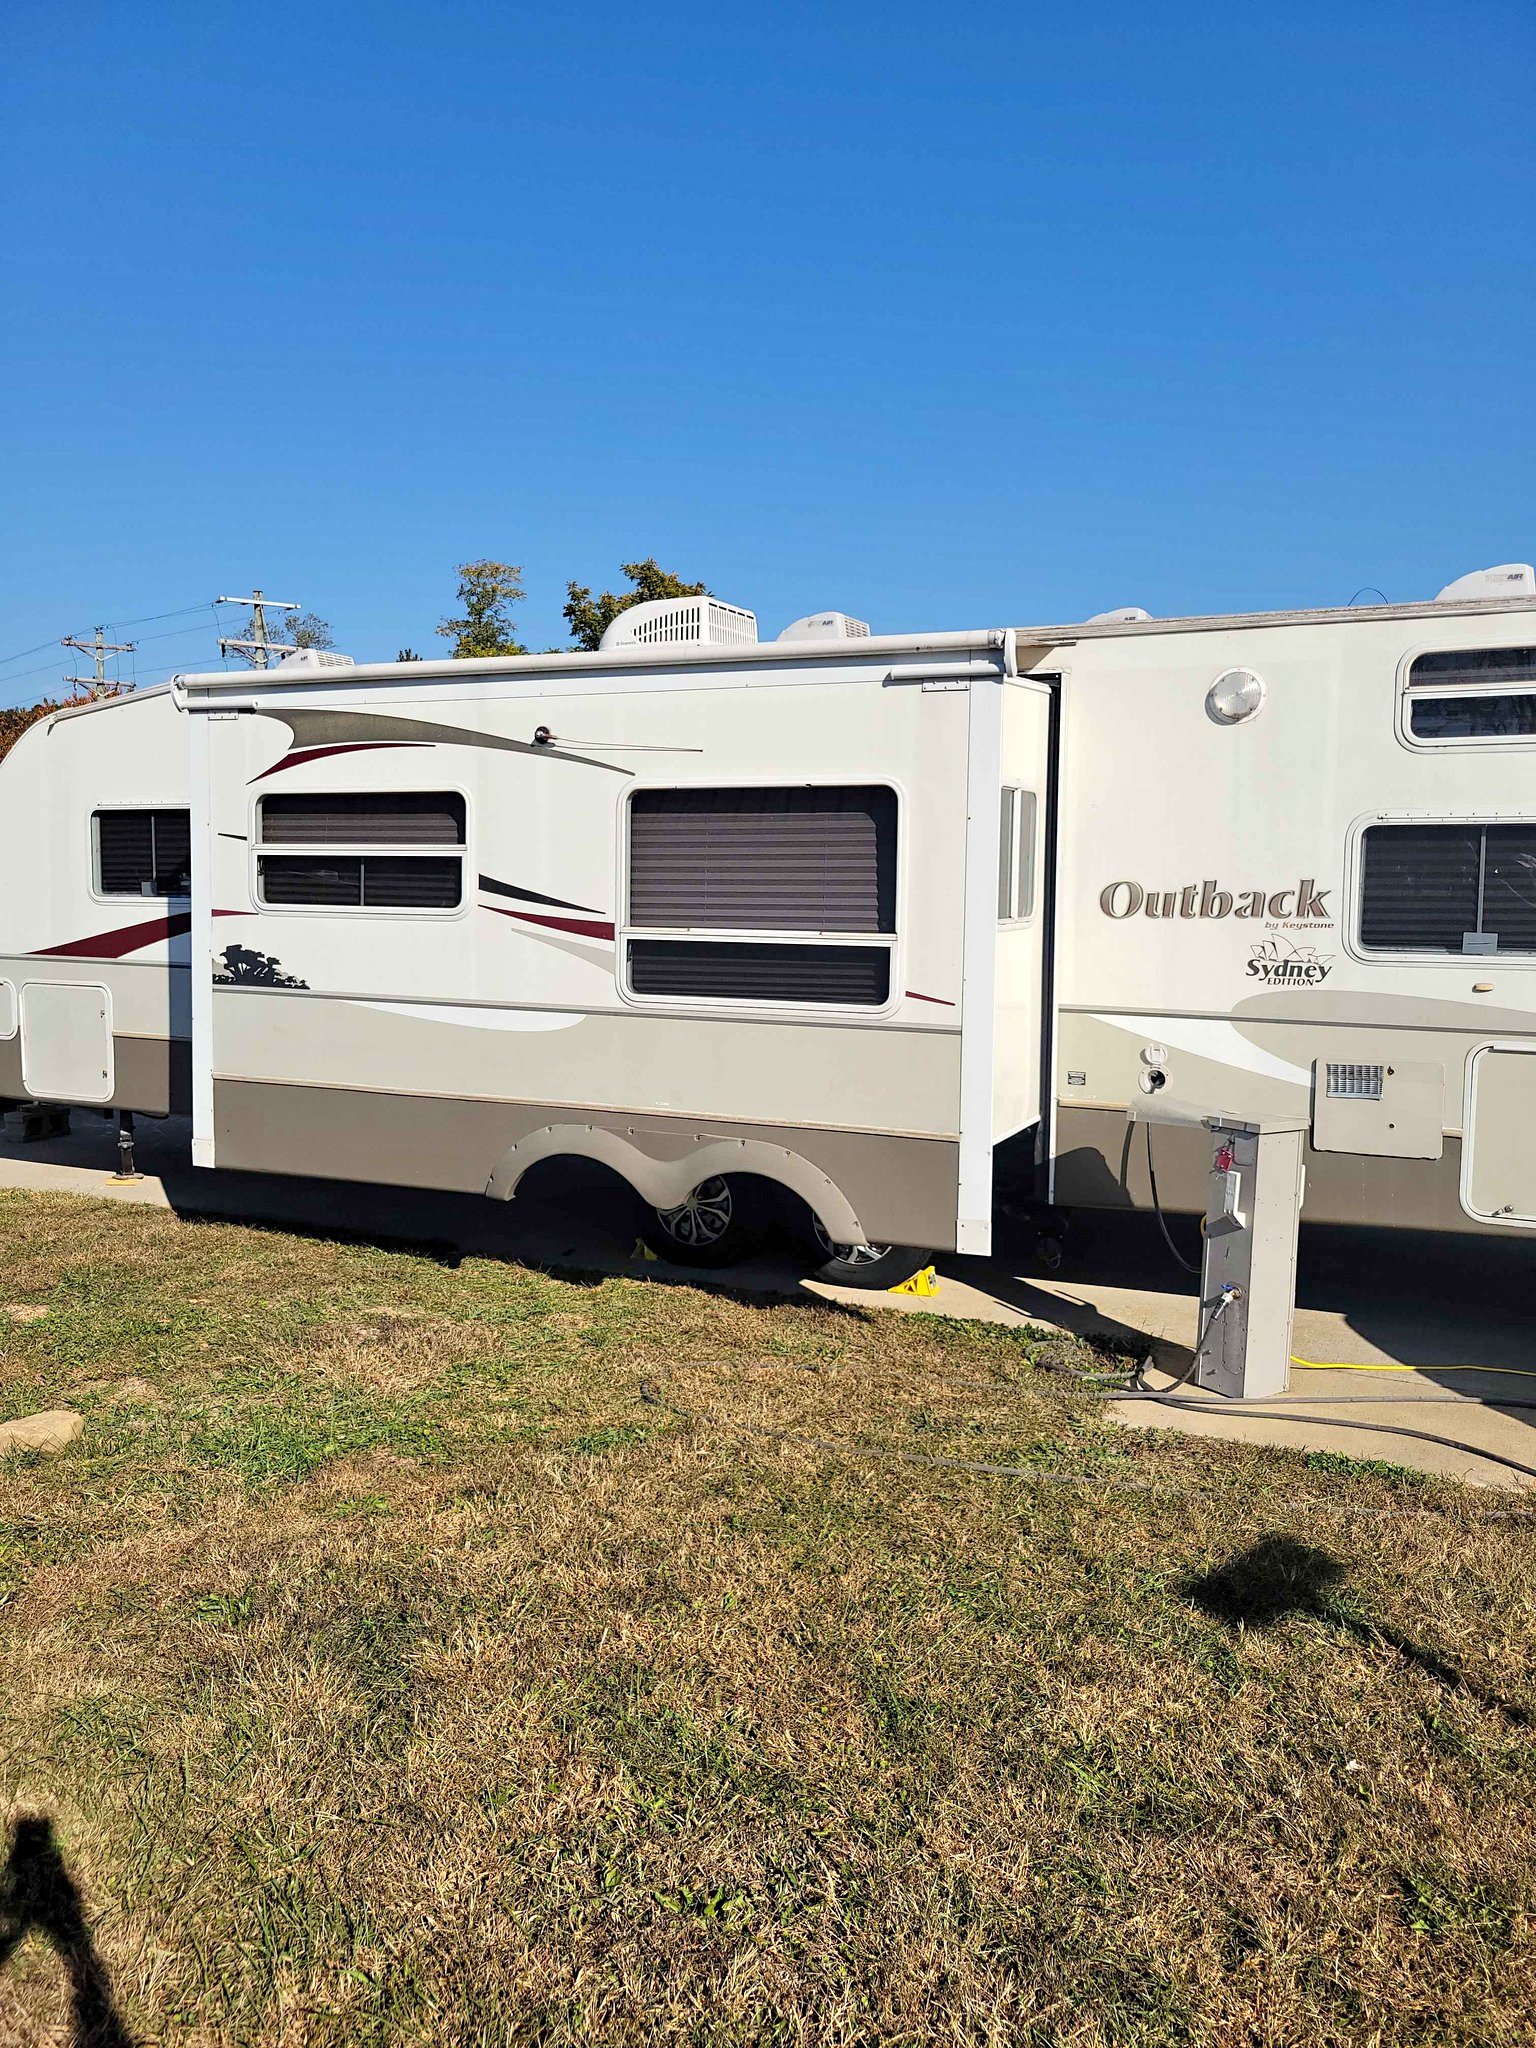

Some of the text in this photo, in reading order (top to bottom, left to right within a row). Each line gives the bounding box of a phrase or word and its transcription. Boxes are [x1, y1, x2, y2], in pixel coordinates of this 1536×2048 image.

[1099, 878, 1332, 919] Outback
[1264, 921, 1334, 931] by Keystone
[1245, 959, 1333, 983] Sydney
[1267, 977, 1315, 986] EDITION
